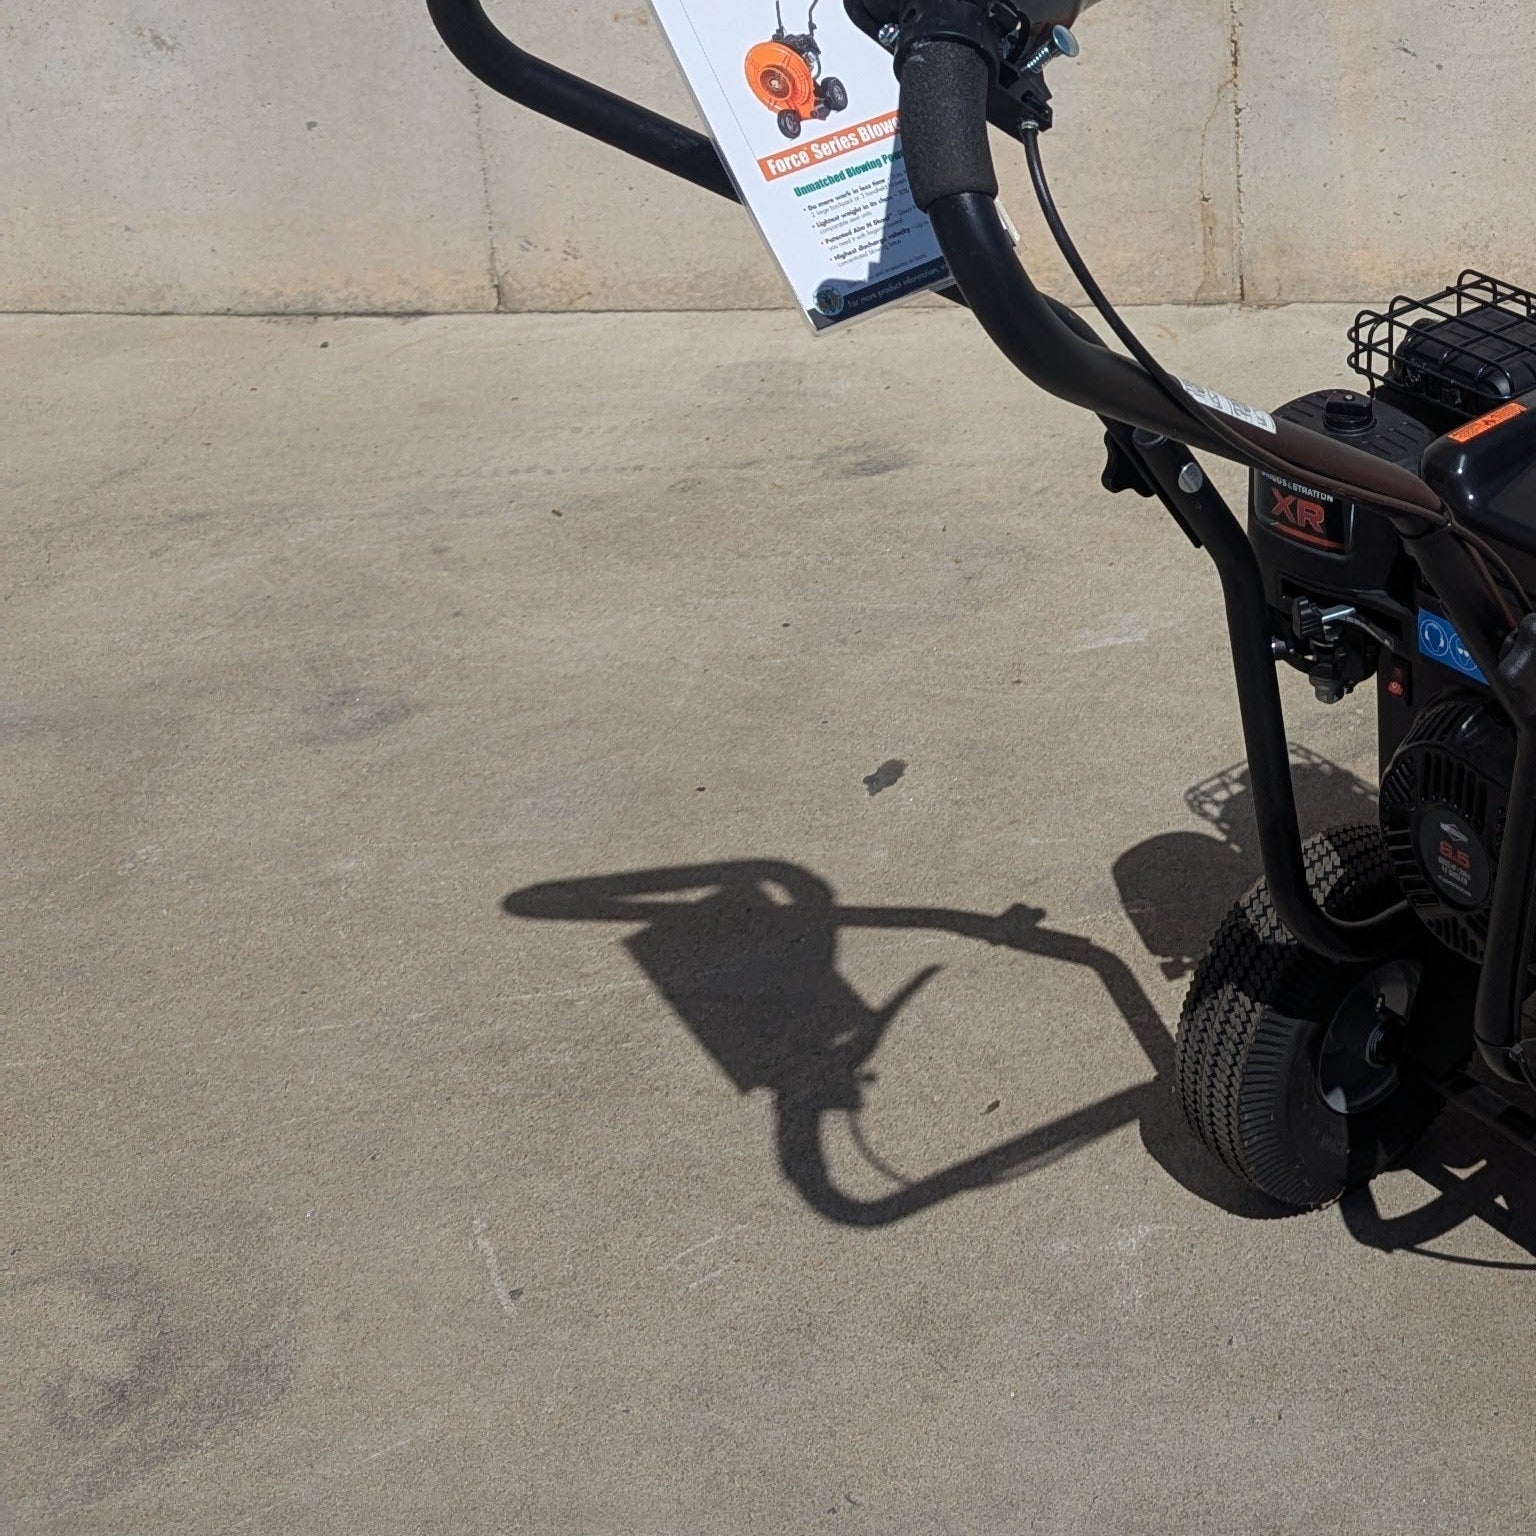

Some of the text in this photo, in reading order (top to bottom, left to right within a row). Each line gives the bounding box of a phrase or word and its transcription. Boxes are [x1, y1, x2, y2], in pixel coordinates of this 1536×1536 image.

[766, 150, 810, 176] Force
[810, 132, 860, 160] Series
[793, 170, 846, 197] Unmatched
[845, 159, 883, 177] Blowing
[836, 191, 851, 201] work
[816, 215, 839, 227] Lightest
[841, 206, 862, 218] weight
[825, 229, 852, 244] Patented
[833, 248, 857, 260] Highest
[858, 237, 887, 251] discharge
[888, 228, 911, 239] velocity
[1293, 482, 1334, 503] STRATTON
[1271, 486, 1325, 534] XR
